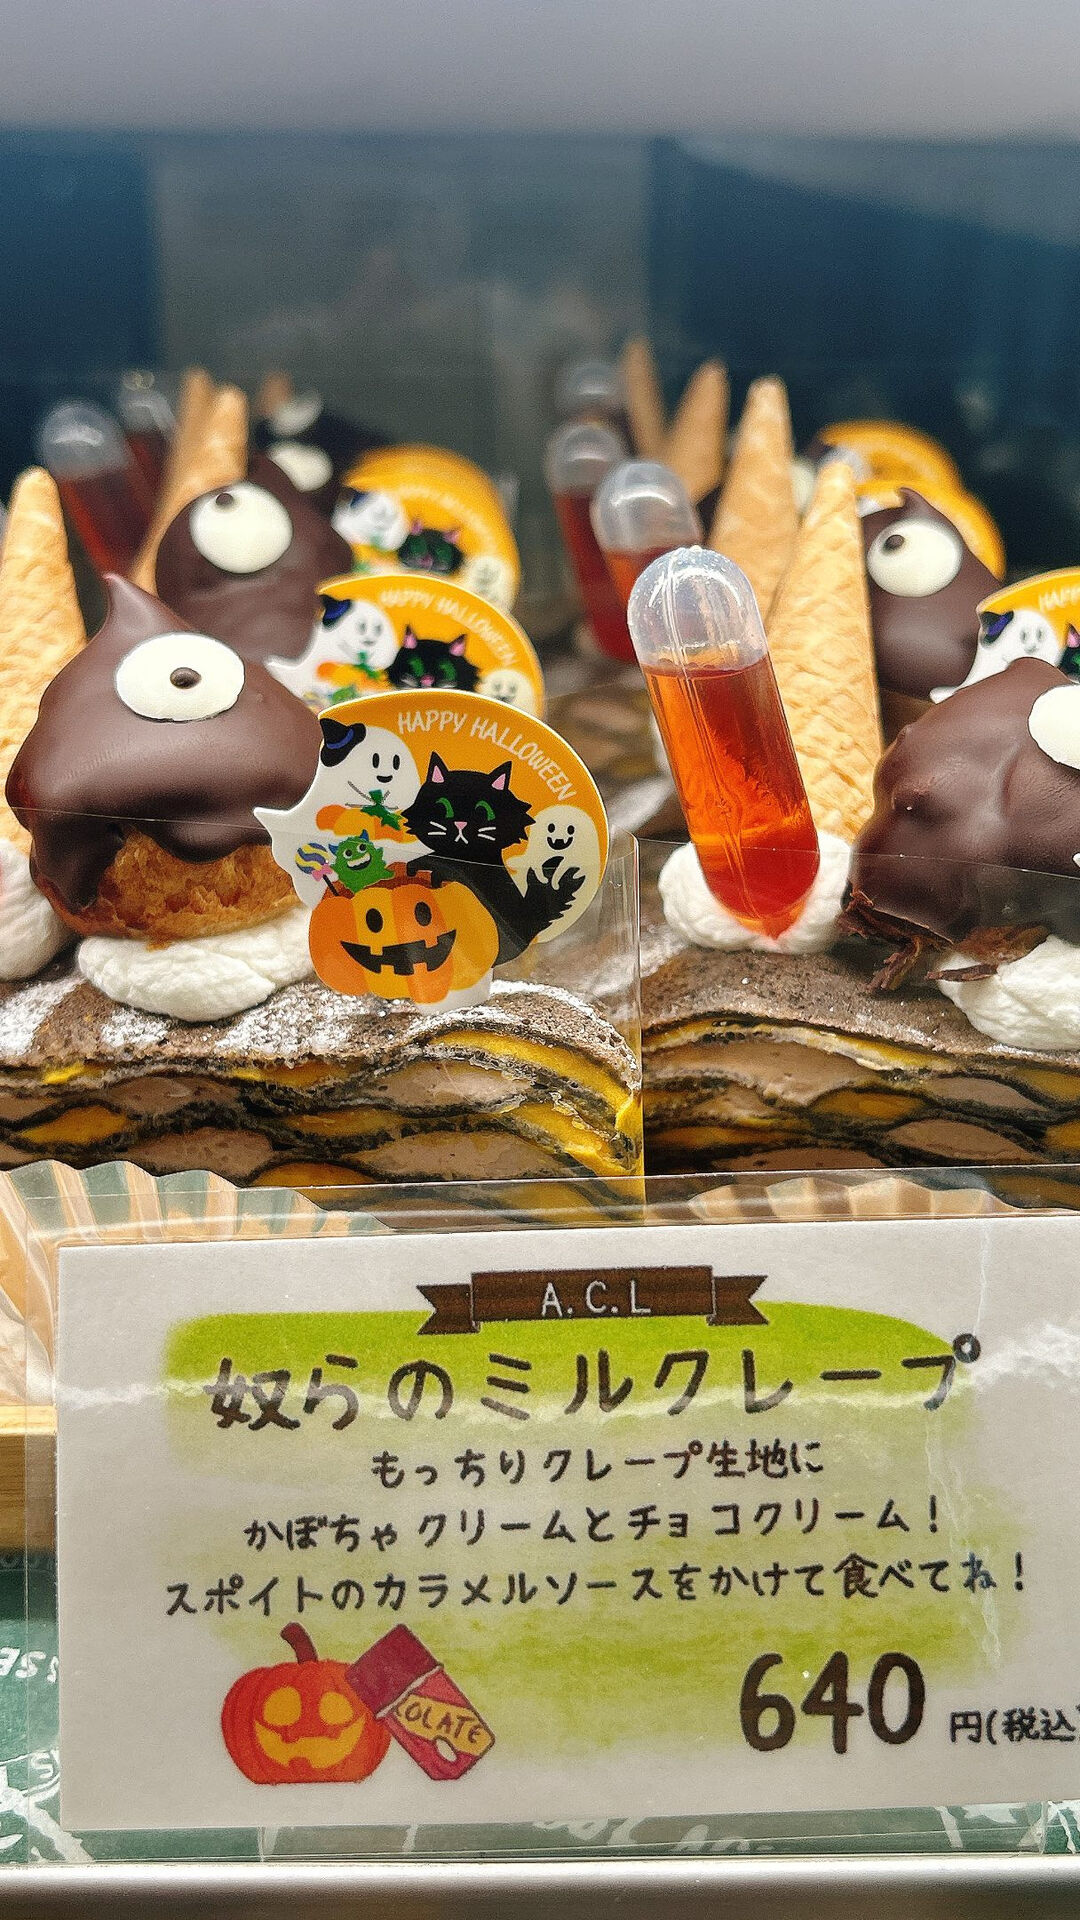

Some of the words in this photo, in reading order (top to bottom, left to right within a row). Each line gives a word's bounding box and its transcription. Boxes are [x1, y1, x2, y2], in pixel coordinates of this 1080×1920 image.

[397, 709, 467, 735] HAPPY
[470, 716, 577, 801] HALLOWEEN
[541, 1279, 651, 1317] A.C.L
[204, 1332, 981, 1431] 奴らのミルクレープ
[372, 1439, 825, 1489] もっちりクレープ生地に
[740, 1651, 926, 1754] 640
[950, 1704, 1080, 1746] 円(税込
